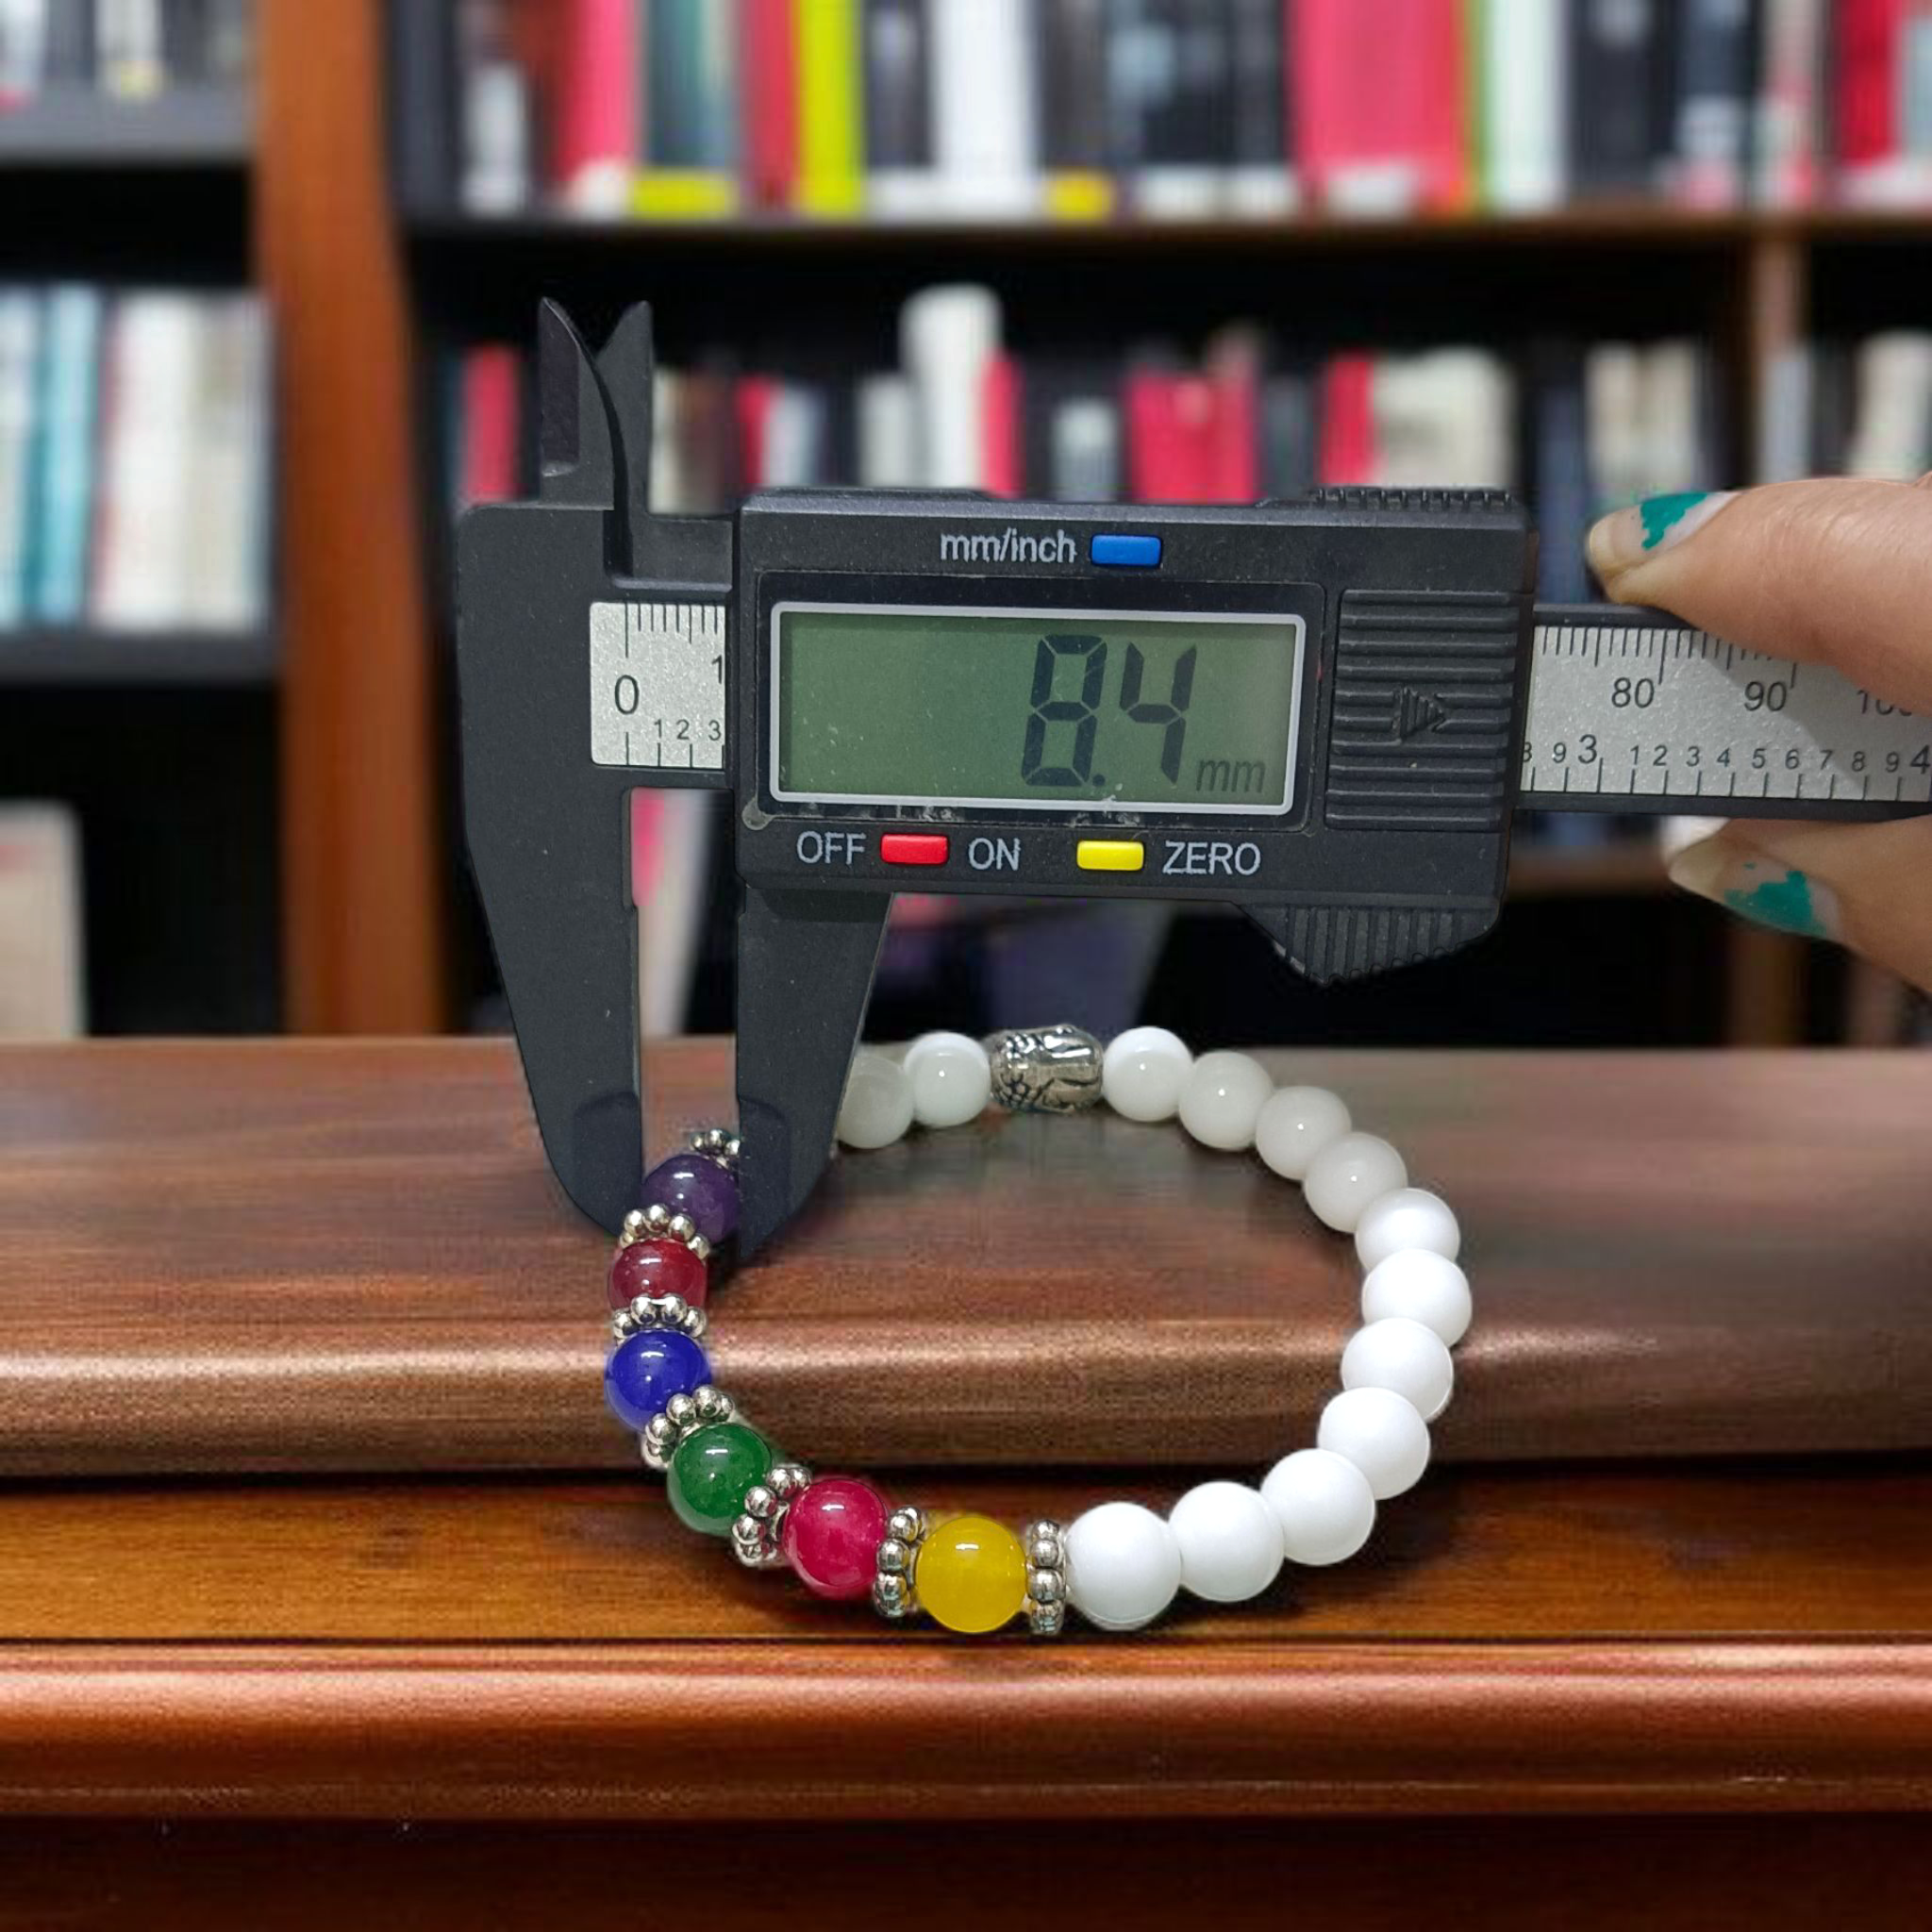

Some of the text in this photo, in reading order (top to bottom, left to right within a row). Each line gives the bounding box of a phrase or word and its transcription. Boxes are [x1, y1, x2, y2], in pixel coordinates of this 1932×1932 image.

[941, 527, 1077, 564] mm/inch
[614, 674, 640, 715] 0
[1021, 633, 1267, 793] 8.4 mm
[1610, 676, 1656, 709] 80
[1743, 680, 1789, 712] 90
[654, 718, 723, 741] 1 2 3
[1552, 741, 1567, 764] 9
[1577, 733, 1598, 765] 3
[1629, 744, 1641, 766] 1
[1652, 744, 1669, 767] 2
[1685, 745, 1701, 768] 3
[1716, 747, 1731, 768] 4
[1751, 747, 1766, 770] 5
[1784, 748, 1800, 770] 6
[1820, 749, 1834, 771] 7
[1851, 750, 1867, 773] 8
[1885, 751, 1900, 774] 9
[1909, 744, 1931, 775] 4
[796, 831, 1262, 876] OFF ON ZERO
